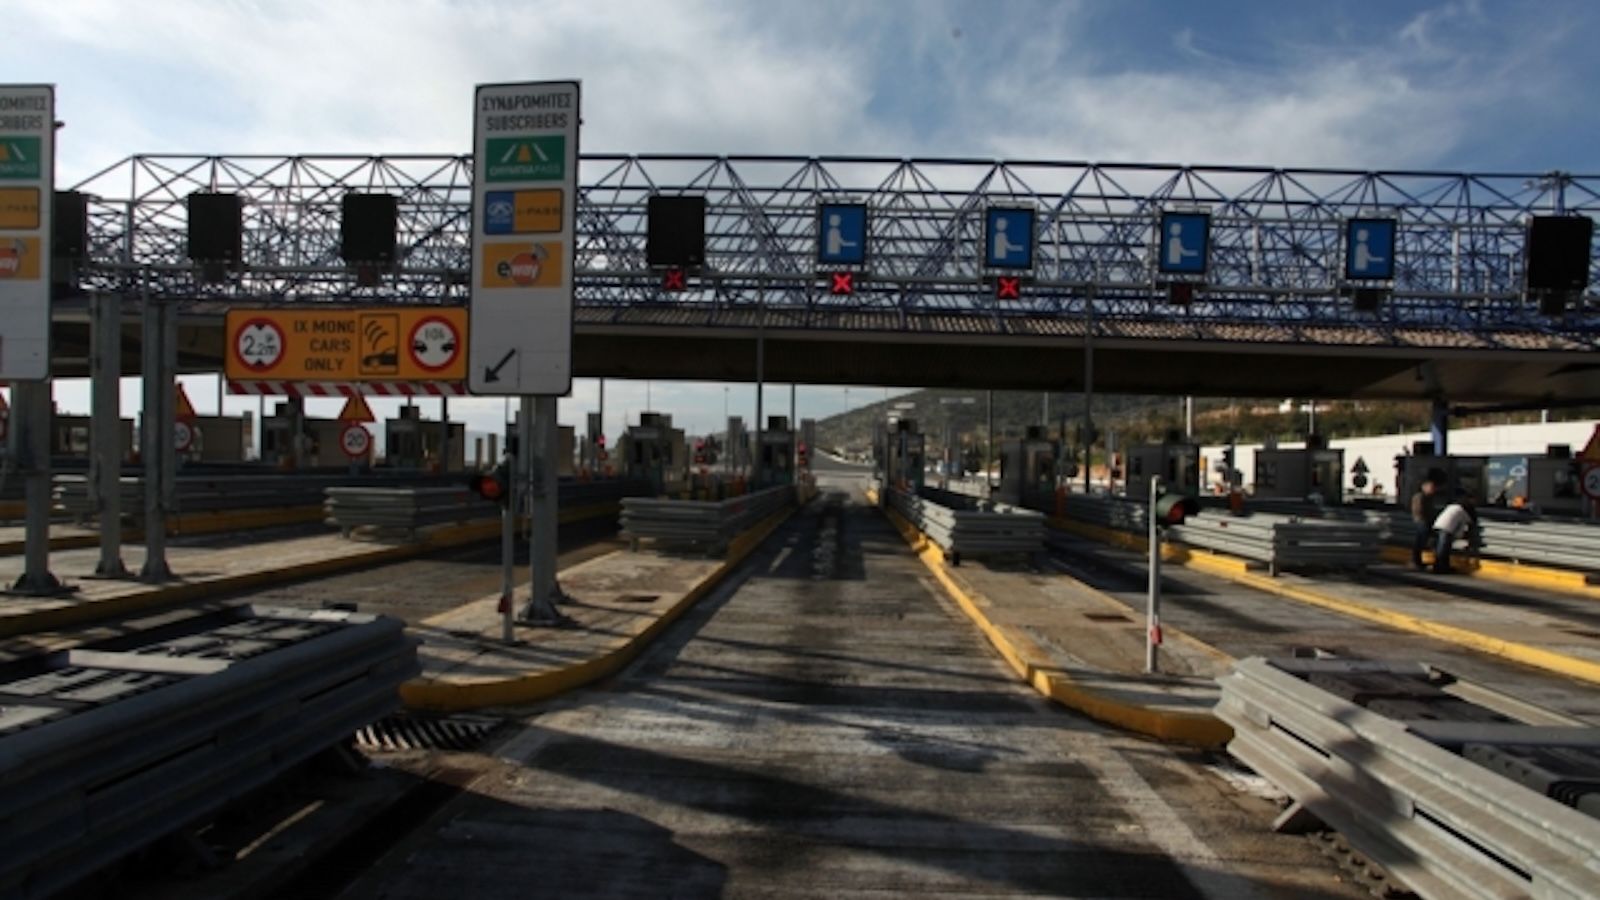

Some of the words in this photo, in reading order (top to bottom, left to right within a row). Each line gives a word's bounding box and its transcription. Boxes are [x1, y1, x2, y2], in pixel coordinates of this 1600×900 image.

[486, 112, 568, 131] SUBSCRIBERS
[309, 336, 352, 353] CARS
[304, 354, 345, 371] ONLY
